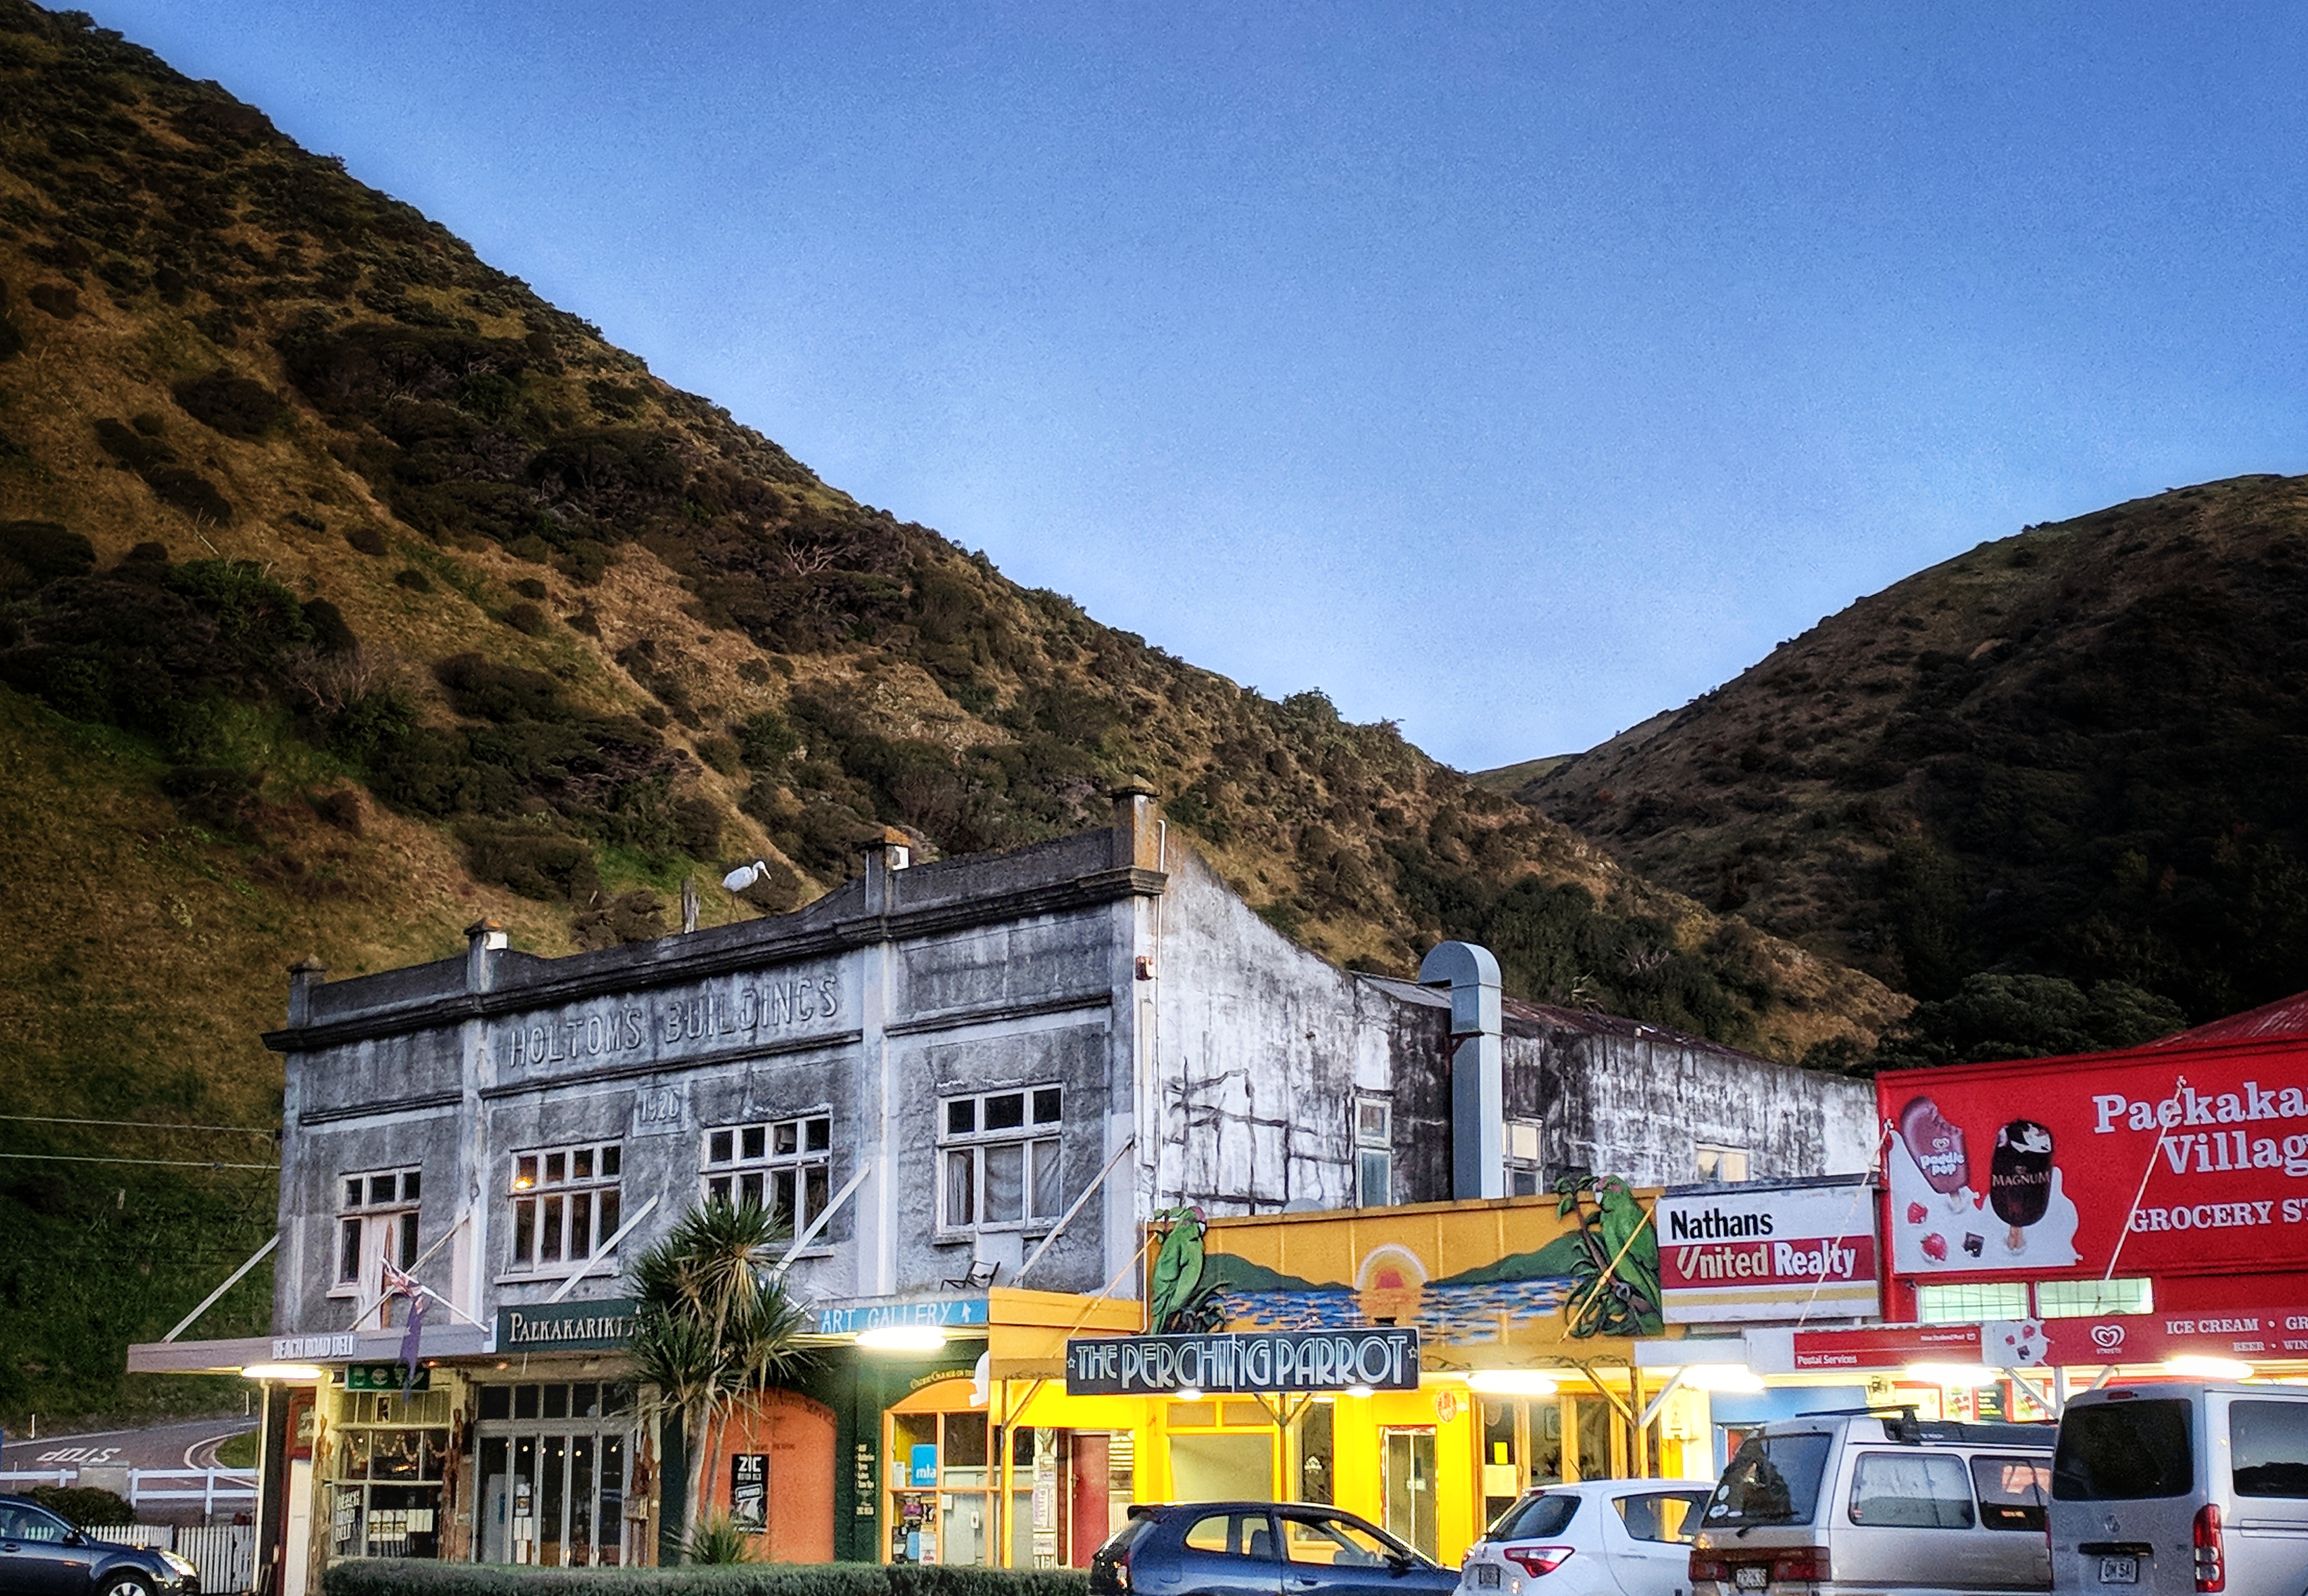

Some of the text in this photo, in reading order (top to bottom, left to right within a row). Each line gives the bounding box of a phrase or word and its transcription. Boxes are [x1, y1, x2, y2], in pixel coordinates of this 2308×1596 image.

[664, 972, 838, 1044] BUILDINGS
[2092, 1082, 2308, 1134] Paekaka
[1919, 1152, 1965, 1169] paddle
[1932, 1164, 1957, 1176] pop
[1992, 1172, 2050, 1186] MAGNUM
[1670, 1208, 1773, 1240] Nathans
[2129, 1201, 2274, 1233] GROCERY
[1677, 1240, 1856, 1280] United Realty
[509, 1312, 623, 1343] PAEKAKARIKI
[820, 1302, 952, 1333] ART GALLERY
[2166, 1320, 2195, 1334] ICE
[2198, 1318, 2260, 1334] CREAM
[332, 1335, 354, 1357] DELI
[1797, 1354, 1858, 1365] Postal Services
[2233, 1341, 2265, 1352] BEER
[1075, 1335, 1408, 1389] THE PERCHING PARROT
